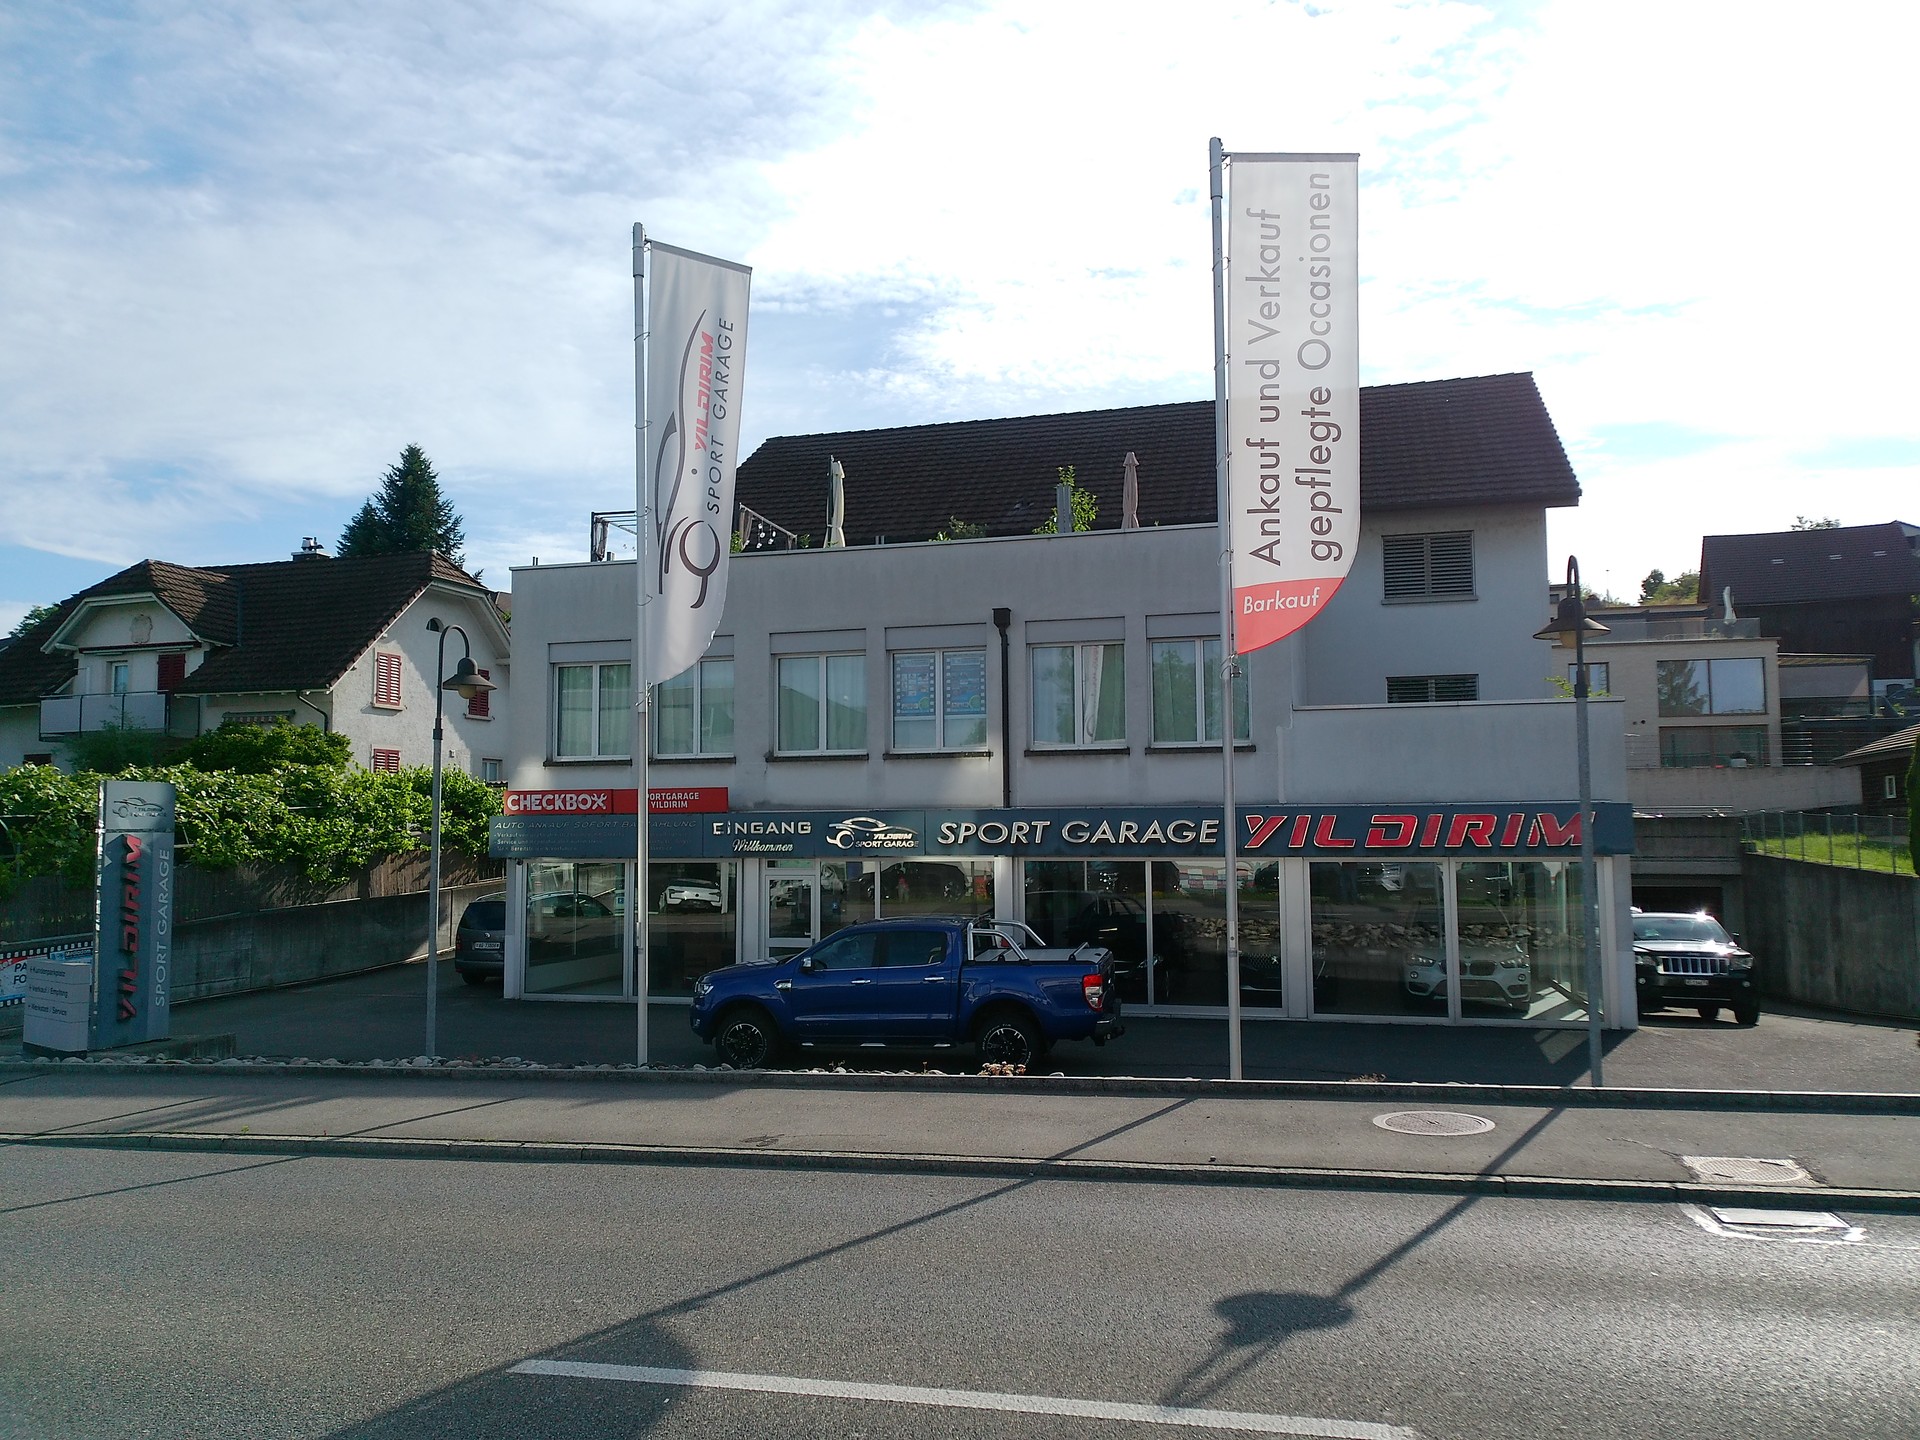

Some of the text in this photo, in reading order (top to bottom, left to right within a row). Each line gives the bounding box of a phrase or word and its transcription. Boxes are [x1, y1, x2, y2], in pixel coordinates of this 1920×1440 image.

[1294, 172, 1343, 563] gepflegte Occasionen
[695, 330, 714, 452] YILDIRIM
[1245, 207, 1281, 566] Ankauf und Verkauf
[706, 318, 734, 515] SPORT GARAGE
[1243, 587, 1320, 614] Barkauf
[506, 793, 607, 812] CHECKBOX
[648, 792, 700, 801] ORTGARAGE
[650, 801, 688, 809] YILDIRIM
[573, 821, 618, 829] SOFORT
[937, 813, 1596, 849] SPORT GARAGE YILDIRIM
[731, 838, 794, 852] Willkommen
[855, 840, 919, 848] SPORT GARAGE
[120, 834, 143, 1021] YILDIRIM
[155, 849, 171, 1007] SPORT GARAGE
